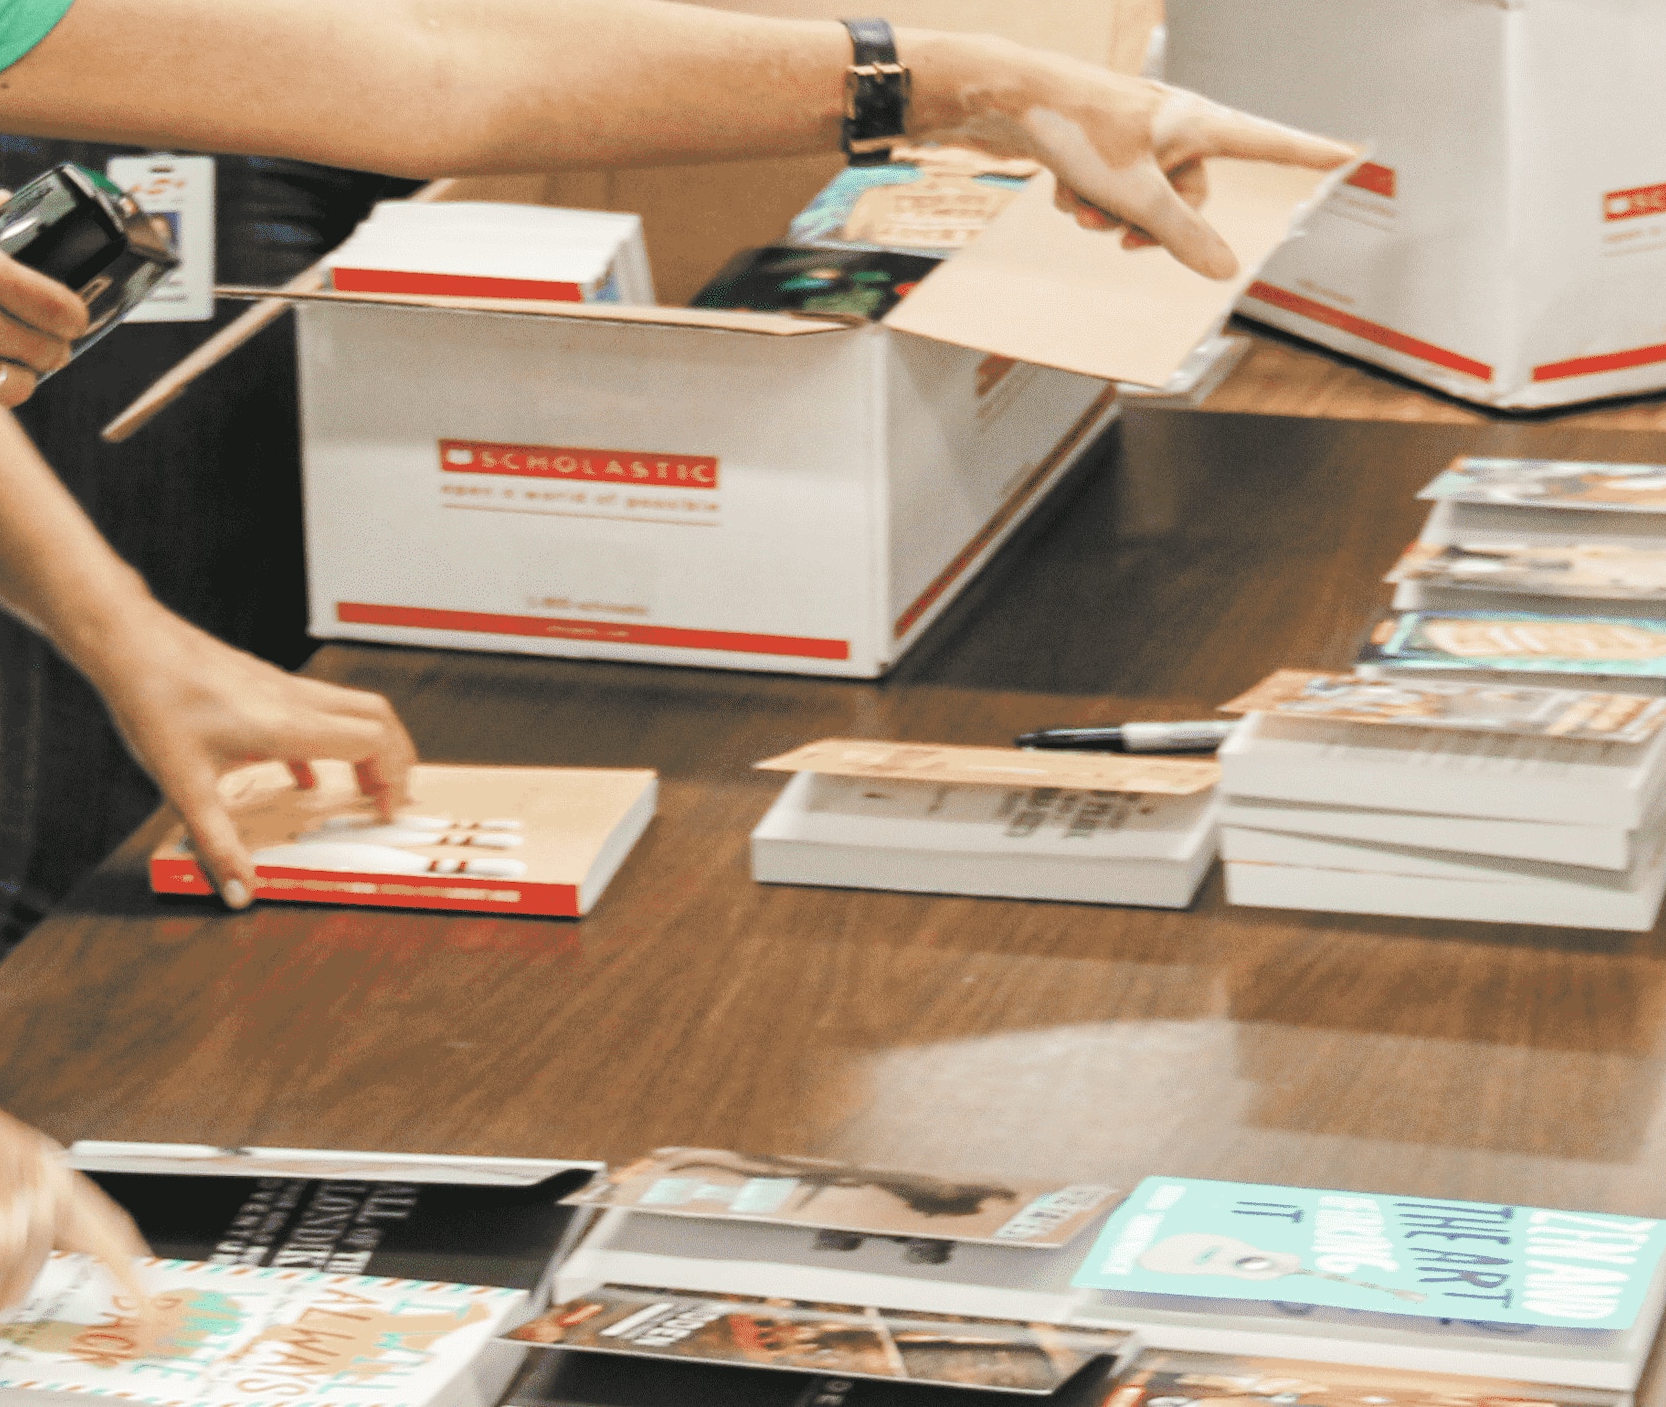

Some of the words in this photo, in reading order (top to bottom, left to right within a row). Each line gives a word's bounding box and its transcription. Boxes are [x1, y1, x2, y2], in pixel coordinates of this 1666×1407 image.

[481, 449, 717, 484] SCHOLASTIC
[1231, 1199, 1304, 1223] IT
[1391, 1200, 1515, 1245] THE
[1525, 1208, 1658, 1264] ZEN
[1407, 1245, 1516, 1308] ART
[1521, 1267, 1632, 1319] AND
[236, 1286, 377, 1398] ALWAYS
